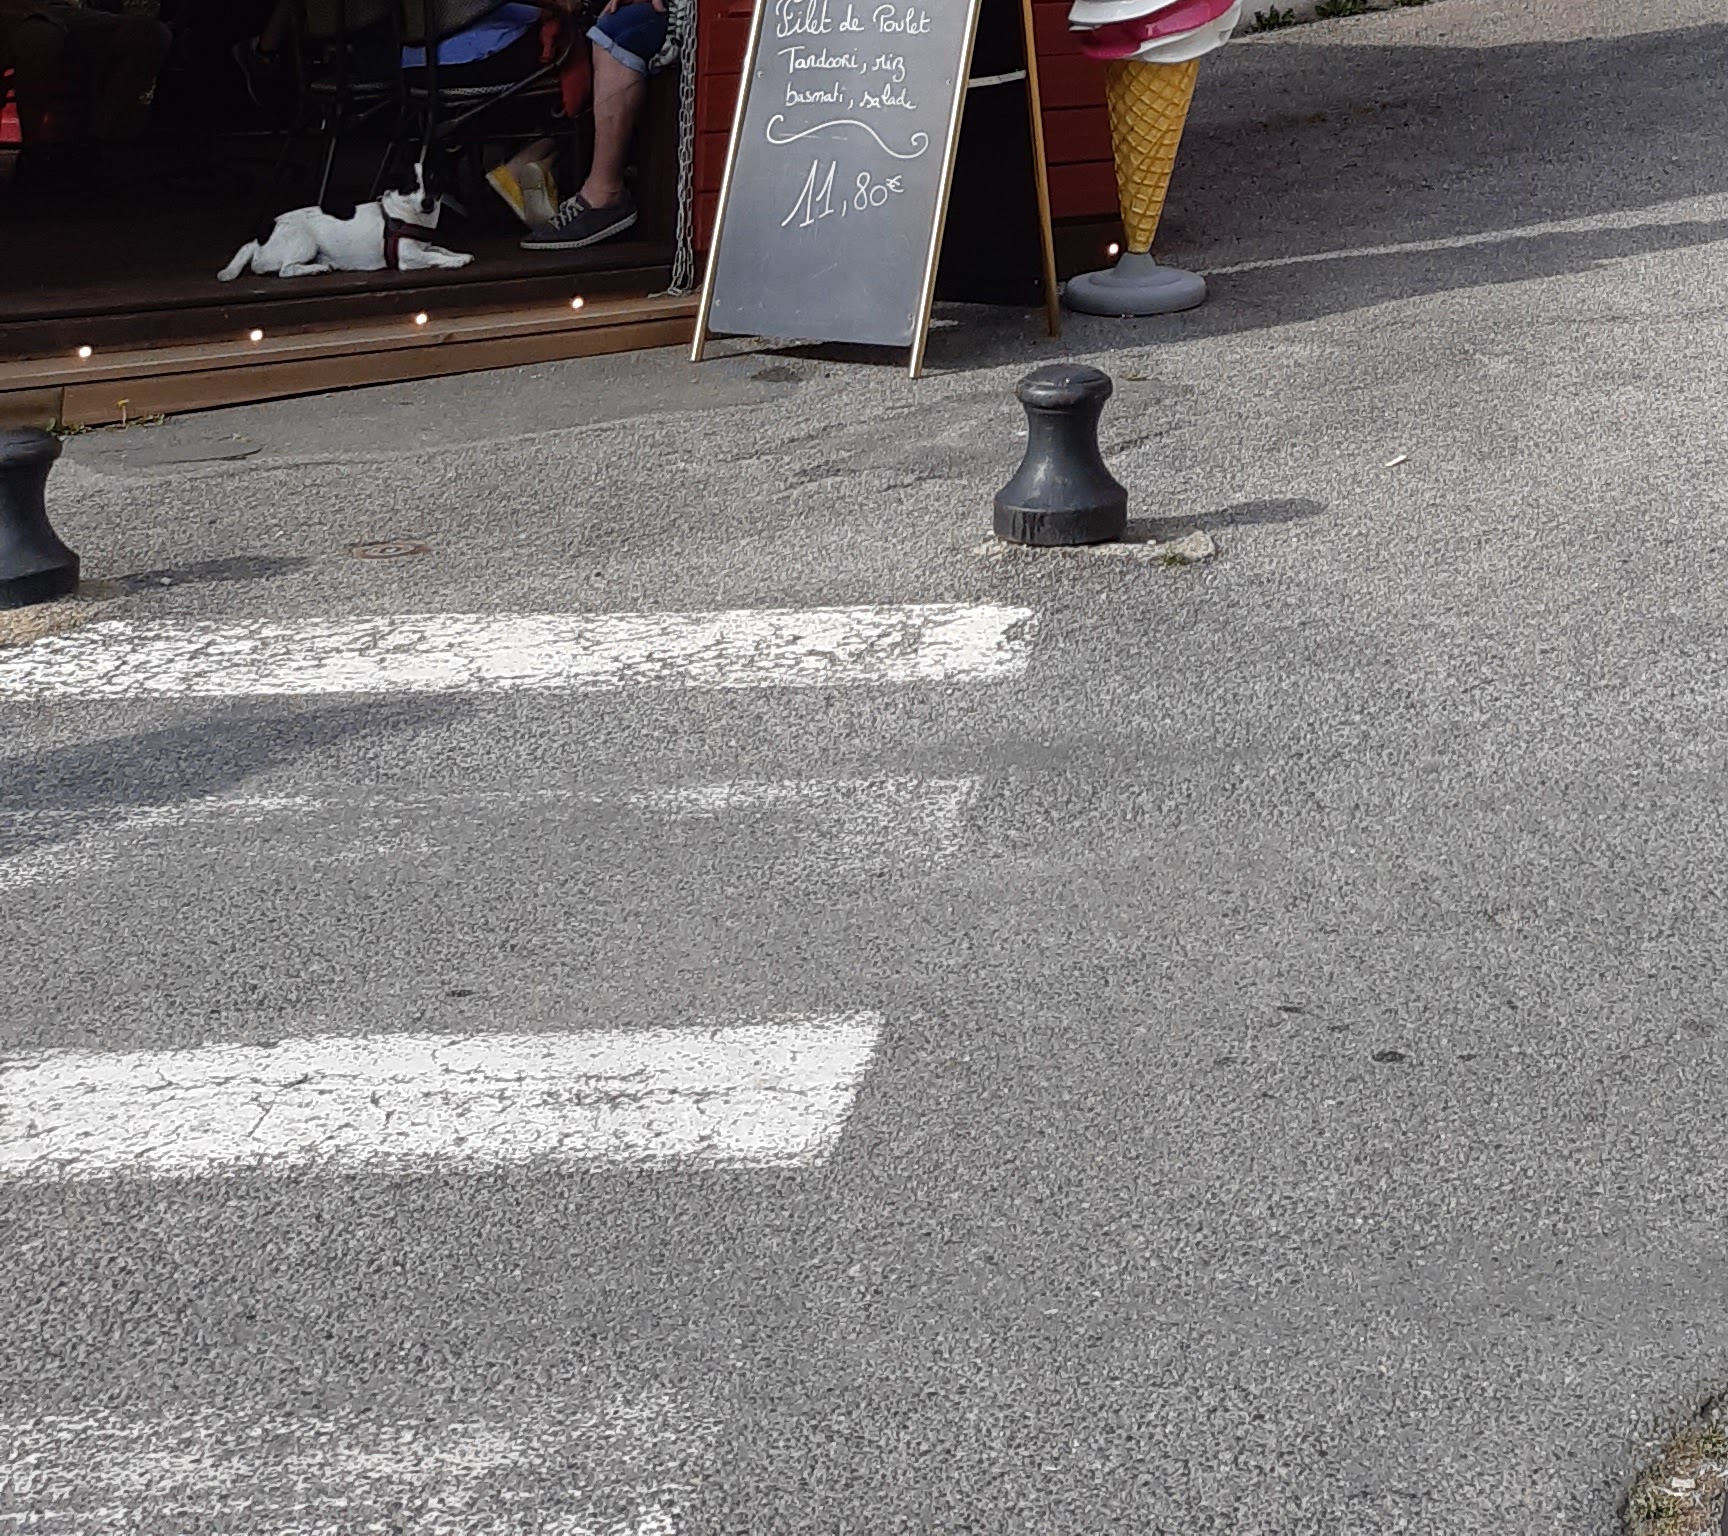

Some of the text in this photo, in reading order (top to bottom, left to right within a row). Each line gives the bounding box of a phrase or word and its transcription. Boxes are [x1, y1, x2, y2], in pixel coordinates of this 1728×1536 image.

[839, 4, 864, 31] de
[872, 4, 931, 34] Poulet
[871, 54, 905, 83] riz
[859, 83, 917, 110] salade
